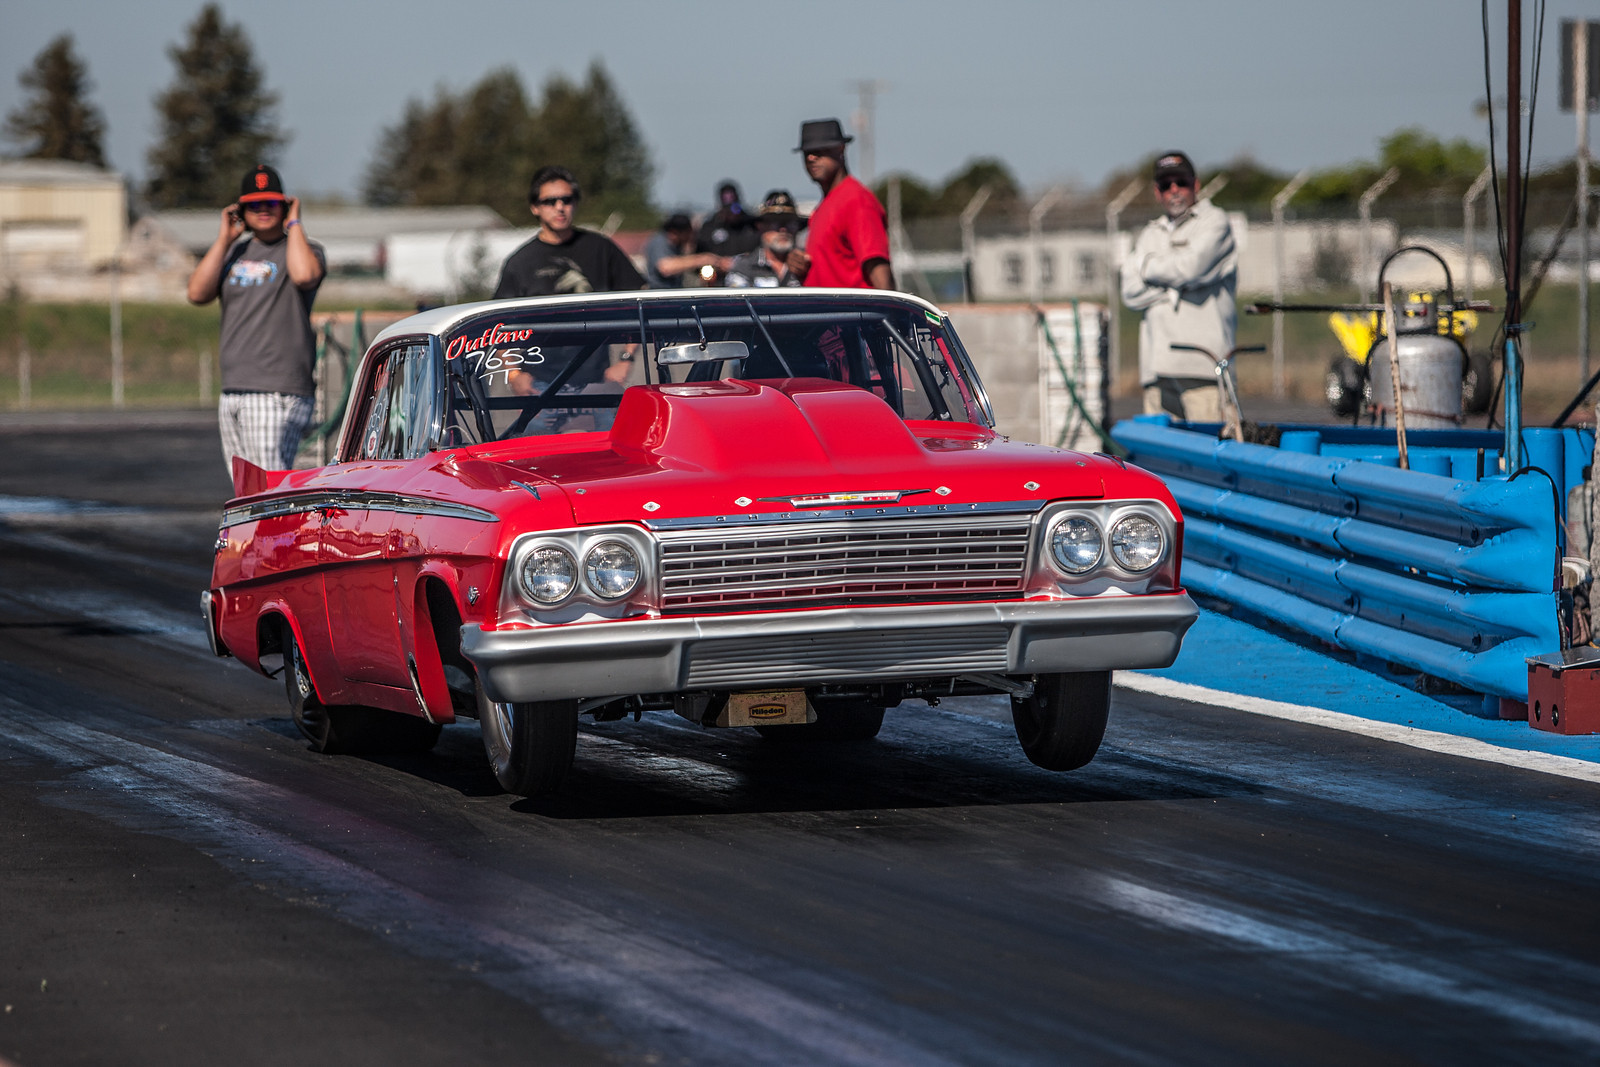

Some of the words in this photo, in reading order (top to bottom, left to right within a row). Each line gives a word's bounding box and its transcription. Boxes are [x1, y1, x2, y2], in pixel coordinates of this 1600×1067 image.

[446, 322, 534, 361] Outlaw
[465, 346, 545, 373] 7653
[715, 503, 978, 522] CHEVROLET
[751, 707, 784, 716] Milodon
